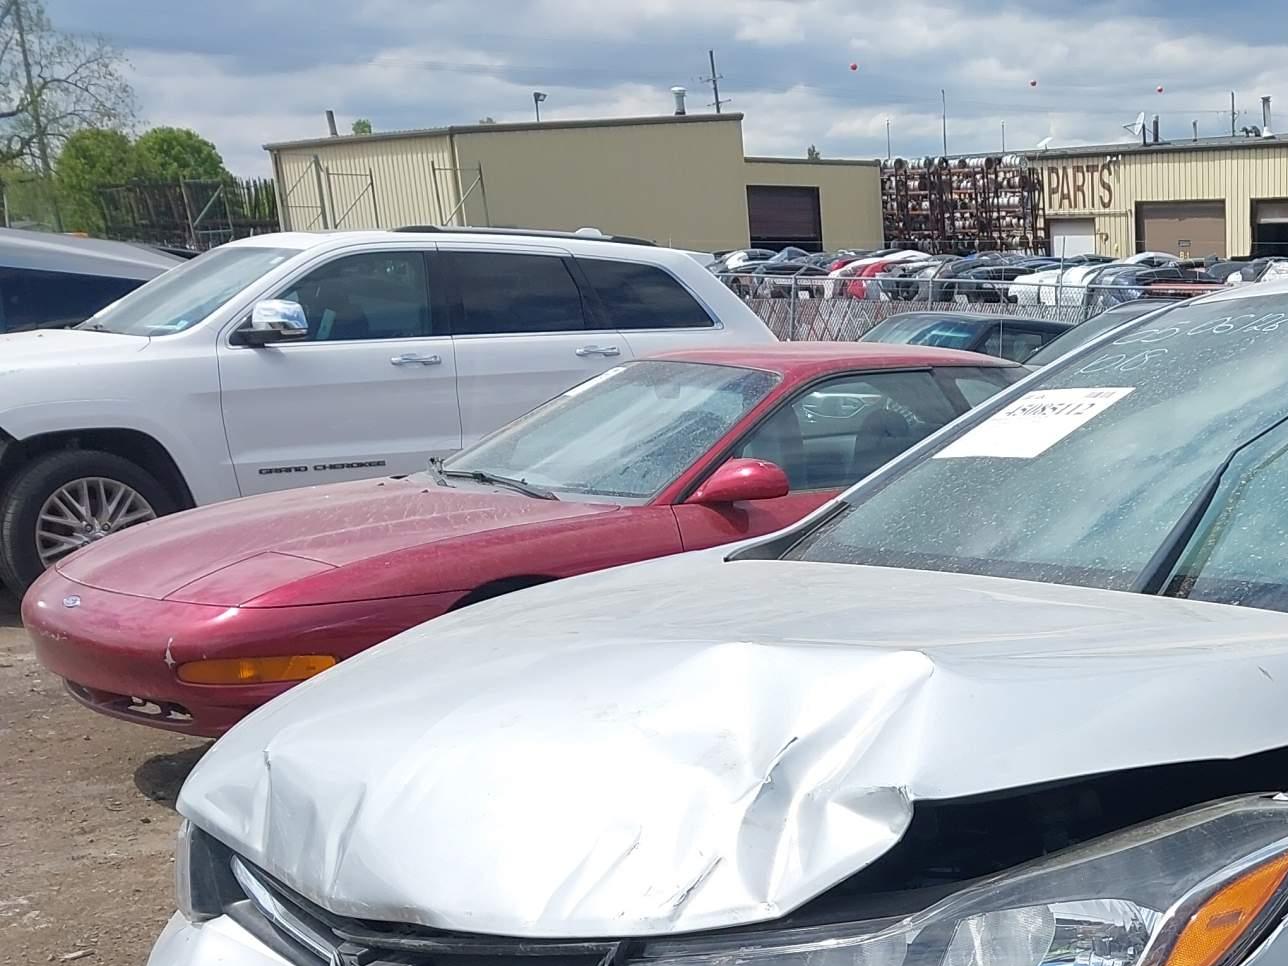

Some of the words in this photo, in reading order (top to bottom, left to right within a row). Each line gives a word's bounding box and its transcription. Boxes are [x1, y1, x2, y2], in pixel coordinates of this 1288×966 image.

[1048, 161, 1113, 209] PARTS
[258, 464, 308, 475] GRAND
[313, 460, 386, 471] CHEROKEE
